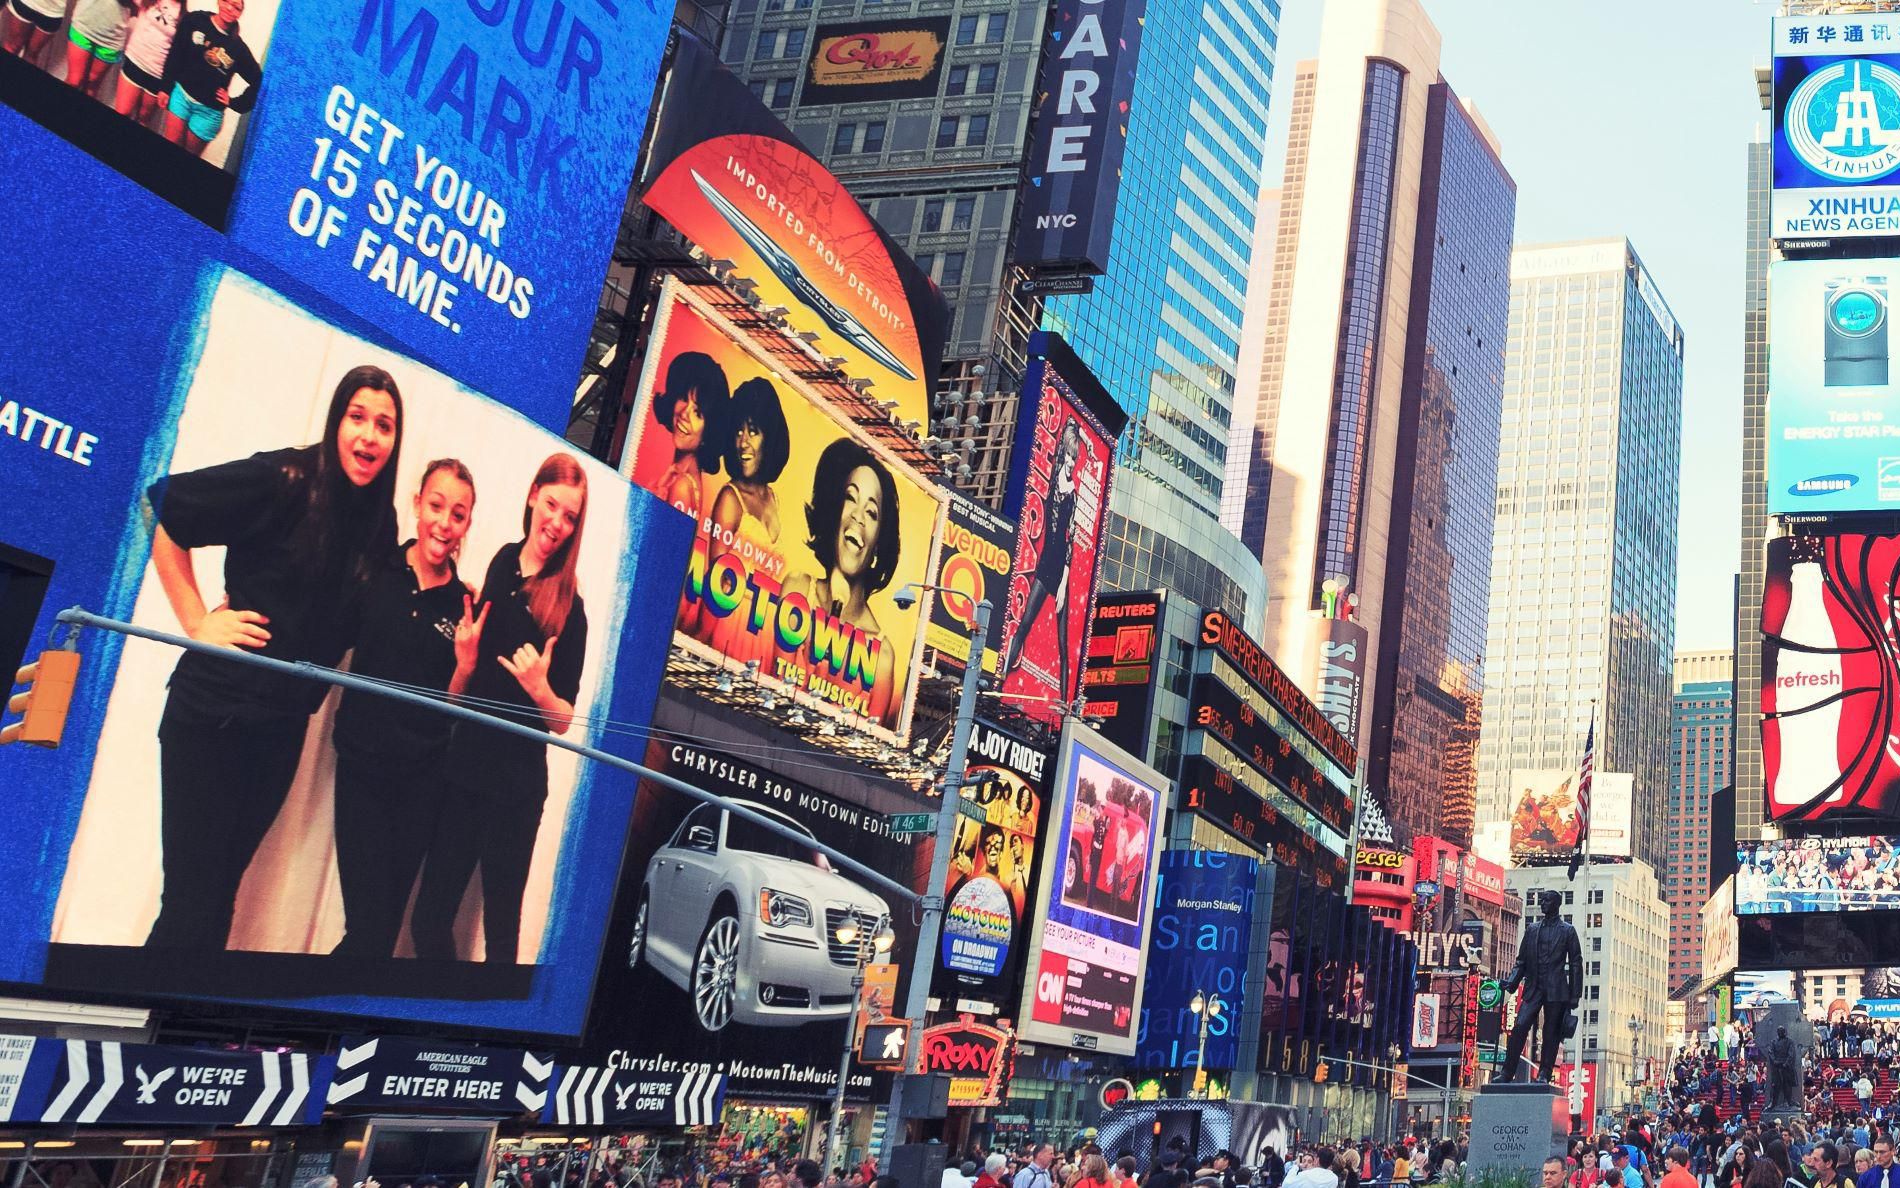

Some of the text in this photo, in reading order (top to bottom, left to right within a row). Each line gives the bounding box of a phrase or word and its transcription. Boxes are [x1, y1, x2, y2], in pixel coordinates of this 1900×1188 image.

[1046, 0, 1108, 173] ARE
[352, 0, 576, 212] MARK
[324, 84, 507, 248] GET YOUR
[1820, 152, 1898, 174] XINHUA
[726, 155, 805, 236] IMPORTED
[808, 233, 845, 278] FROM
[1036, 214, 1077, 229] NYC
[1786, 217, 1841, 233] NEWS
[310, 136, 535, 320] 15 SECONDS
[1783, 239, 1828, 249] SHERWOOD
[288, 187, 462, 334] OF FAME.
[1861, 409, 1884, 422] the
[1784, 426, 1841, 440] ENERGY
[1843, 425, 1880, 439] STAR
[1796, 479, 1851, 492] SAMSUNG
[952, 502, 997, 534] BEST MUSICAL
[1783, 515, 1828, 524] SHERWOOD
[702, 518, 784, 577] BROADWAY
[942, 520, 1011, 576] venue
[940, 553, 986, 632] Q
[1099, 603, 1156, 619] REUTERS
[1201, 612, 1273, 693] SIMEPREVIR
[1272, 669, 1300, 723] PHASE
[776, 657, 870, 717] THE MUSICAL
[1777, 669, 1840, 690] refresh
[1082, 702, 1116, 717] PRICE
[979, 728, 1010, 764] JOY
[1009, 743, 1046, 778] RIDE!
[671, 745, 758, 789] CHRYSLER
[763, 779, 792, 803] 300
[798, 792, 858, 826] MOTOWN
[902, 816, 914, 830] 46
[917, 815, 927, 823] ST
[1822, 836, 1871, 849] HYUNDAI
[1355, 849, 1406, 868] eese's
[1177, 898, 1243, 914] Morgan Stanley
[948, 902, 1010, 932] MOTOWN
[1057, 924, 1073, 942] YOUR
[1073, 930, 1096, 950] PICTURE
[952, 938, 999, 961] ON BROADWAY
[1037, 971, 1065, 1006] CNN
[1463, 974, 1479, 1077] HERSHEYS
[415, 1051, 489, 1067] AMERICAN EAGLE
[428, 1062, 473, 1074] OUTFITTERS
[181, 1066, 249, 1086] WE'RE
[728, 1059, 873, 1088] MotownTheMusic.com
[174, 1088, 232, 1106] OPEN
[381, 1075, 504, 1100] ENTER HERE
[638, 1081, 673, 1096] WE'RE
[634, 1097, 665, 1111] OPEN
[1491, 1125, 1530, 1135] GEORGE
[1493, 1142, 1527, 1152] COHAN
